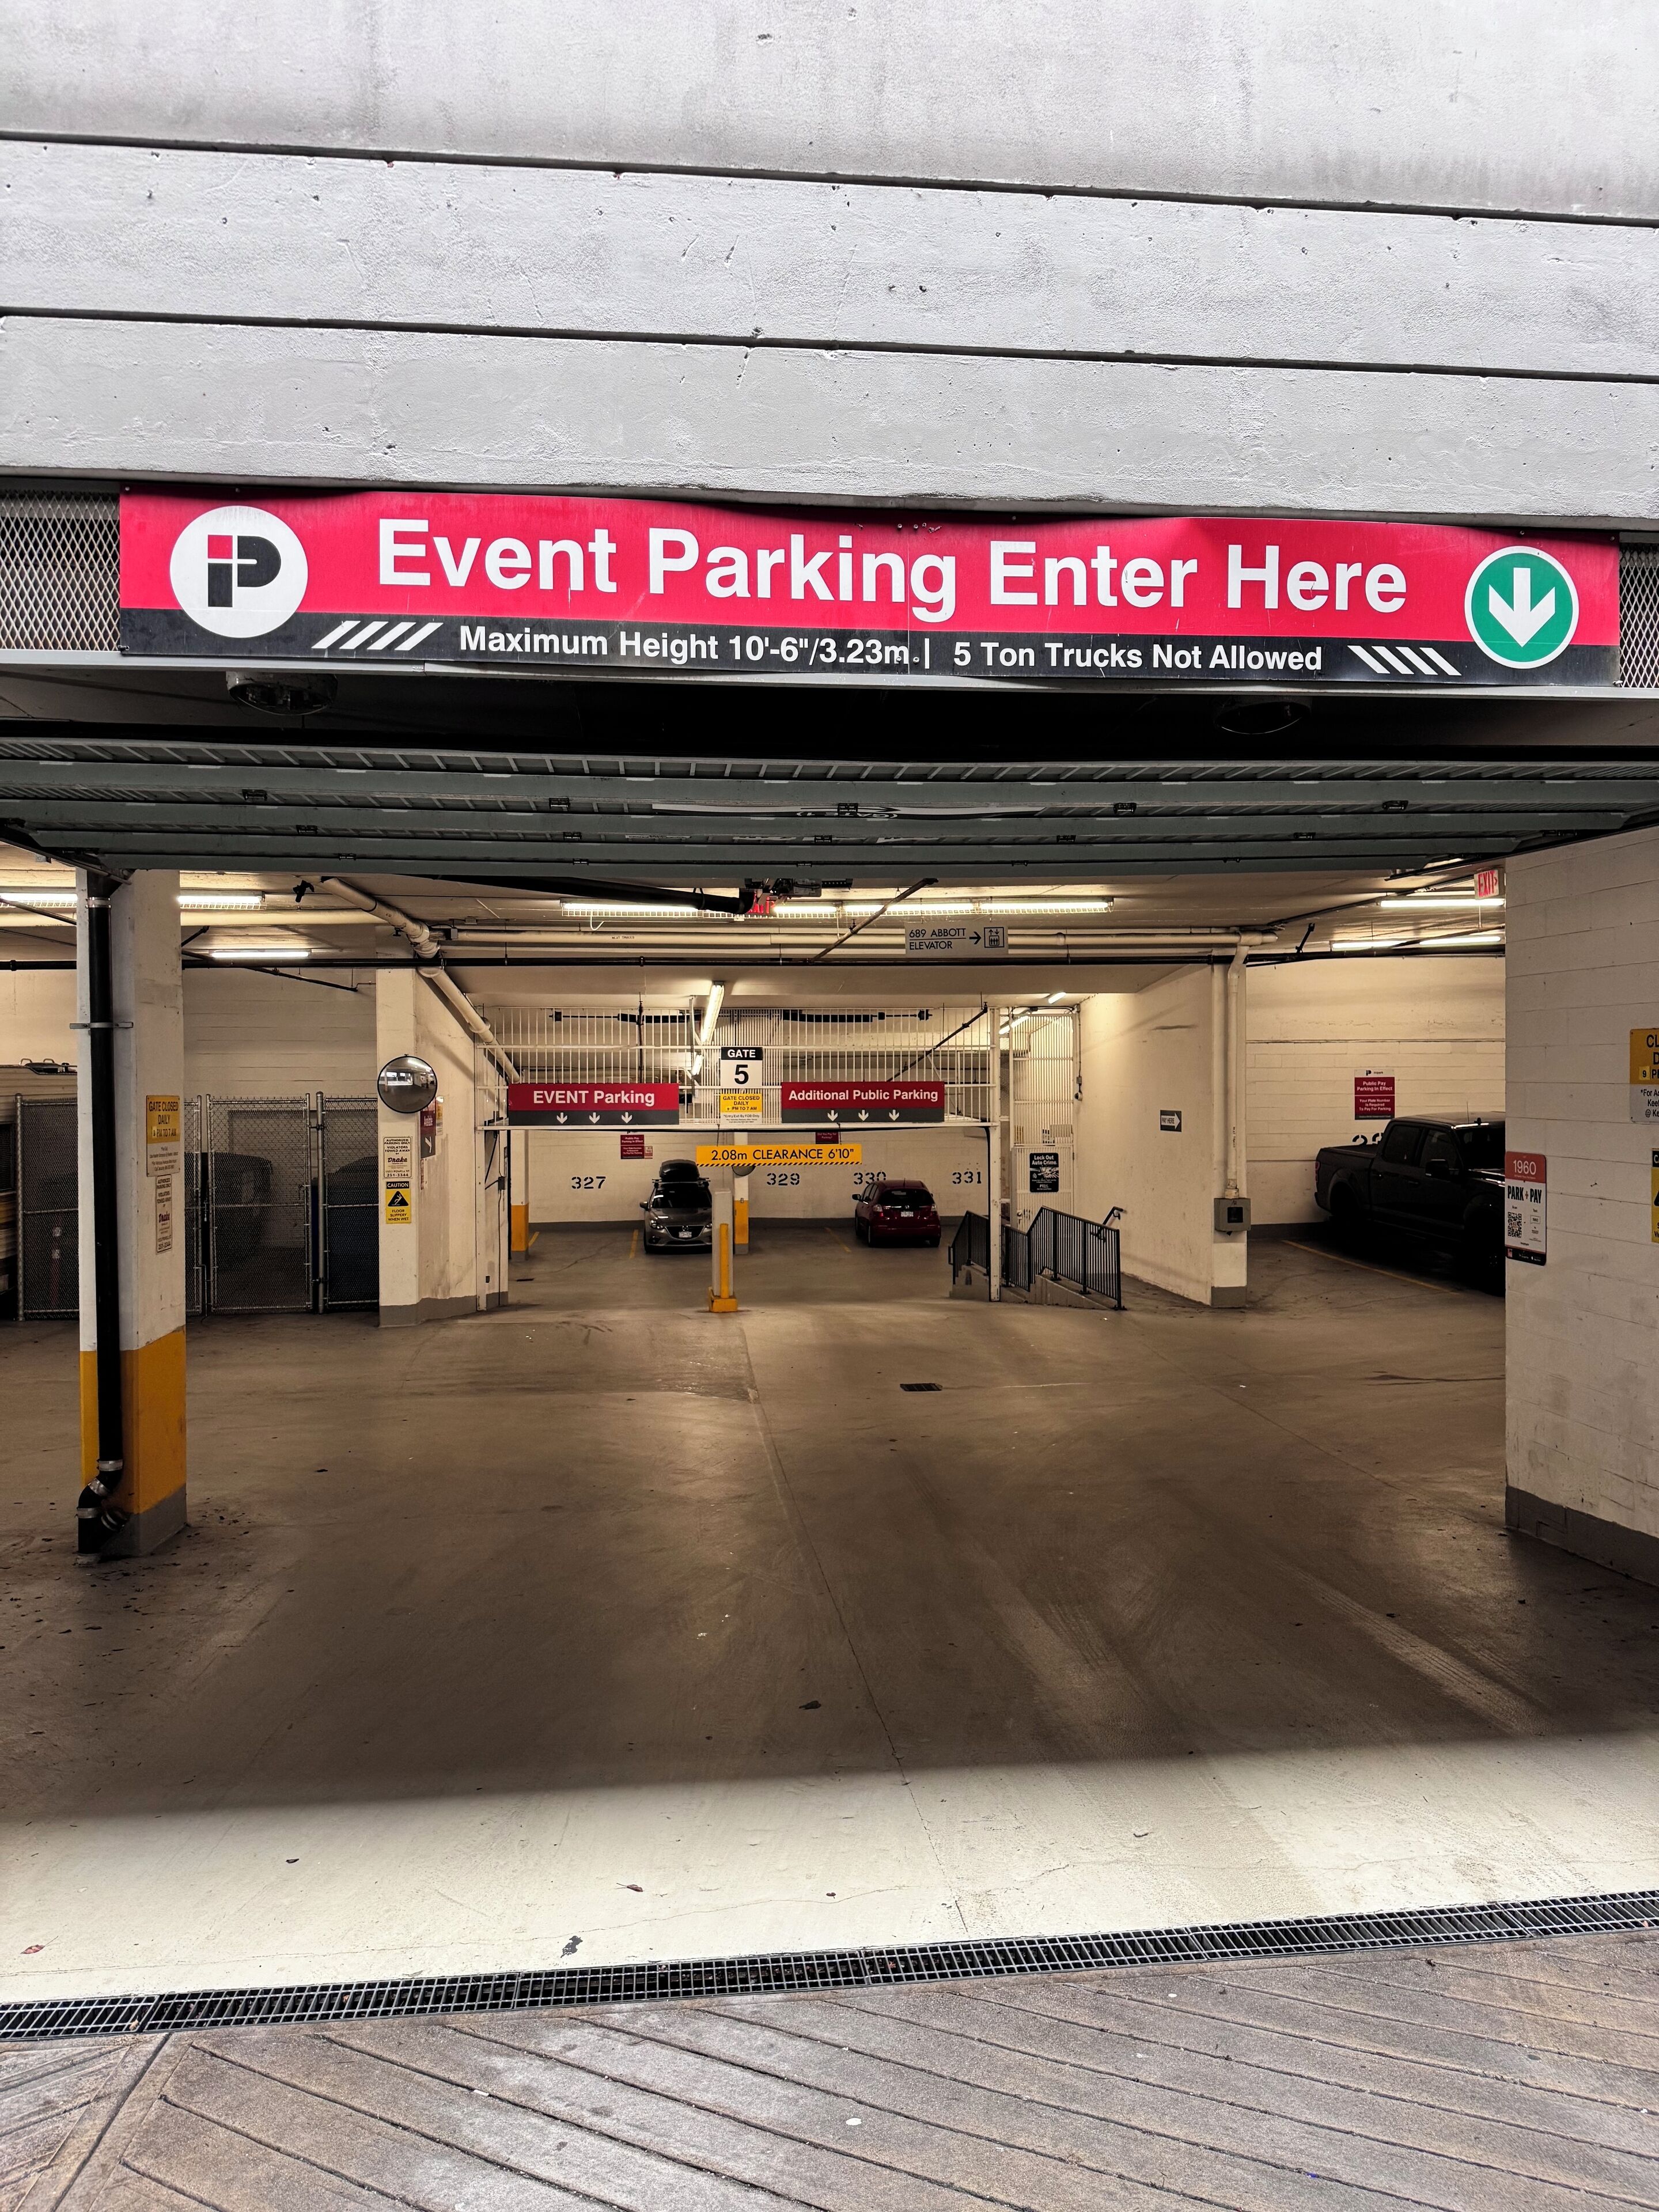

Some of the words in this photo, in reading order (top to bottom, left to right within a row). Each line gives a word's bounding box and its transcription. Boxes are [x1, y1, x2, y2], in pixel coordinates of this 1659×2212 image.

[379, 518, 616, 594] Event
[649, 527, 956, 623] Parking
[990, 540, 1198, 608] Enter
[1228, 544, 1407, 613] Here
[460, 625, 608, 656] Maximum
[619, 632, 719, 665] Height
[953, 641, 971, 666] 5
[980, 641, 1036, 668] Ton
[1045, 642, 1143, 669] Trucks
[1153, 644, 1202, 670] Not
[1209, 645, 1322, 671] Allowed
[1478, 870, 1495, 898] EXIT
[909, 929, 926, 938] 689
[930, 928, 967, 937] ABBOTT
[909, 941, 953, 950] ELEVATOR
[727, 1049, 756, 1058] GATE
[734, 1064, 749, 1085] 5
[1642, 1070, 1646, 1078] 9
[1652, 1069, 1659, 1079] P
[533, 1090, 589, 1104] EVENT
[594, 1090, 655, 1107] Parking
[789, 1089, 850, 1101] Additional
[853, 1089, 890, 1101] Public
[893, 1089, 938, 1103] Parking
[149, 1101, 161, 1112] GATE
[162, 1101, 179, 1112] CLOSED
[1645, 1109, 1652, 1118] @
[158, 1114, 171, 1125] DAILY
[162, 1128, 168, 1137] TO
[171, 1128, 177, 1137] AM
[711, 1150, 748, 1161] 2.08m
[752, 1148, 823, 1160] CLEARANCE
[828, 1148, 855, 1160] 6'10"
[1513, 1160, 1537, 1175] 1960
[571, 1176, 607, 1190] 327
[767, 1172, 801, 1187] 329
[952, 1171, 982, 1185] 331
[1508, 1185, 1524, 1201] PARK
[1530, 1188, 1542, 1203] PAY
